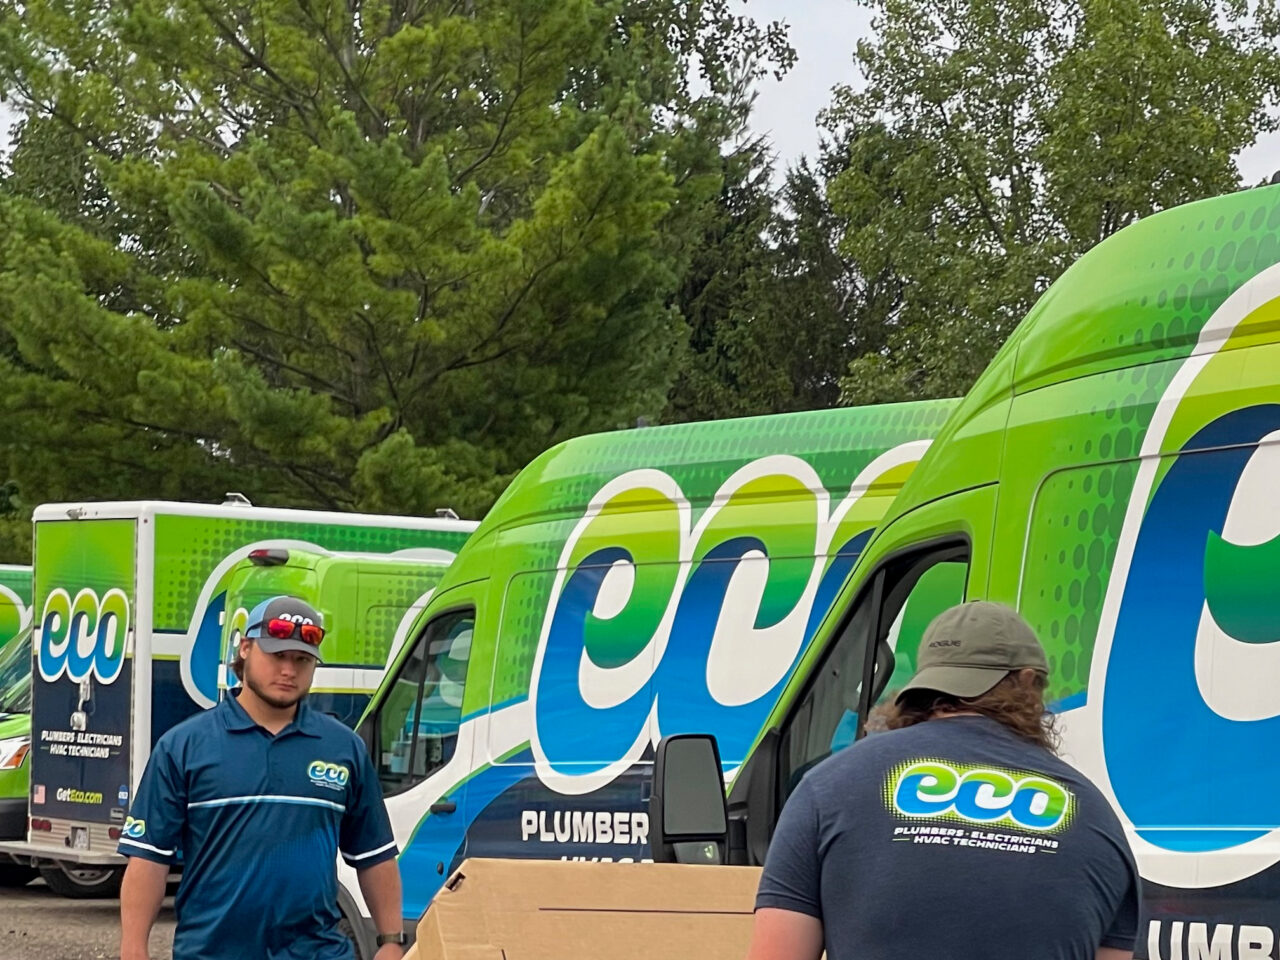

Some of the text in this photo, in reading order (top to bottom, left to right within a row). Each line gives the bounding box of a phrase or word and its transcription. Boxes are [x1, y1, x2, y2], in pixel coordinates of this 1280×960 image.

[38, 587, 130, 685] eco
[41, 730, 123, 746] PLUMBERS ELECTRICIANS
[50, 743, 110, 758] HVAC TECHNICIANS
[309, 760, 349, 786] eco
[57, 787, 103, 804] GetEco.com
[893, 762, 1070, 830] eco
[521, 810, 650, 845] PLUMBER
[893, 826, 1059, 849] PLUMBERS ELECTRICIANS
[914, 835, 1036, 854] HVAC TECHNICIANS
